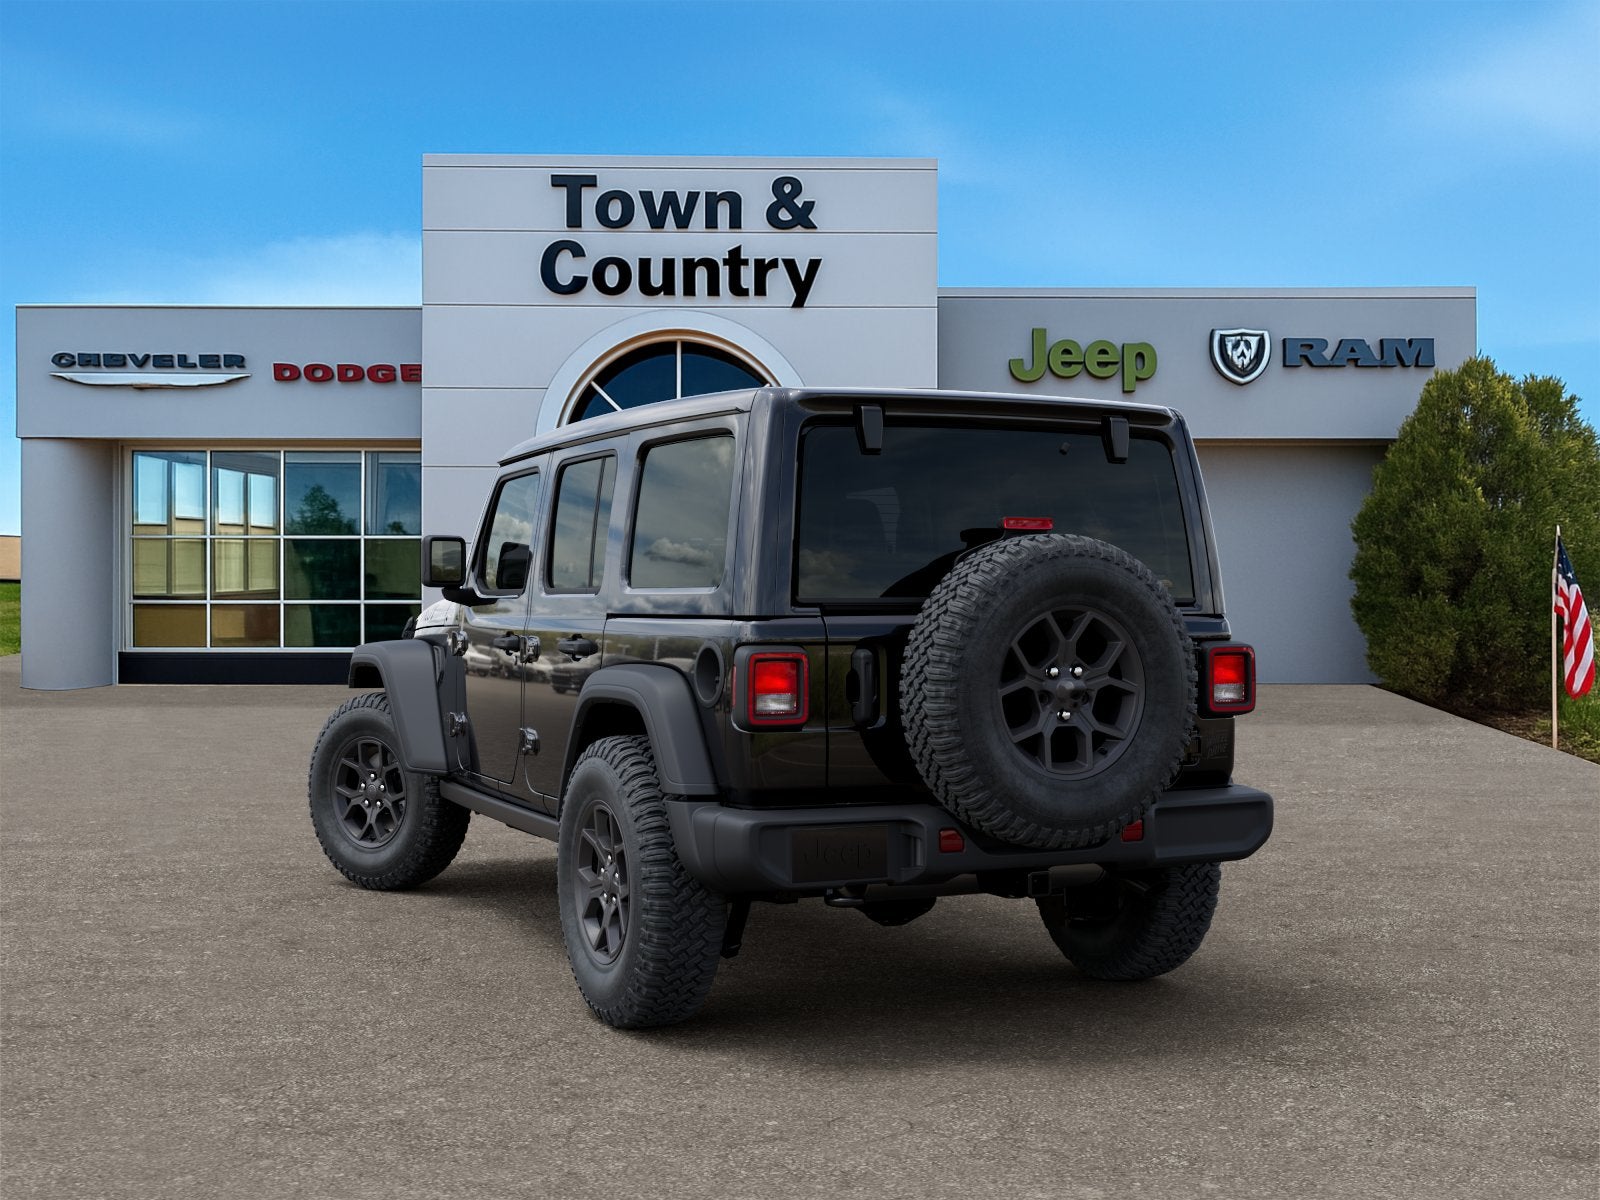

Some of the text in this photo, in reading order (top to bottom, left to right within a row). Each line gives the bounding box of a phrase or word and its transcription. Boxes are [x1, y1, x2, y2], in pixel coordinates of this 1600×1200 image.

[550, 173, 819, 230] Town &
[540, 239, 823, 309] Country
[273, 363, 422, 383] DODGE
[1009, 328, 1157, 393] Jeep
[1283, 338, 1436, 368] RAM
